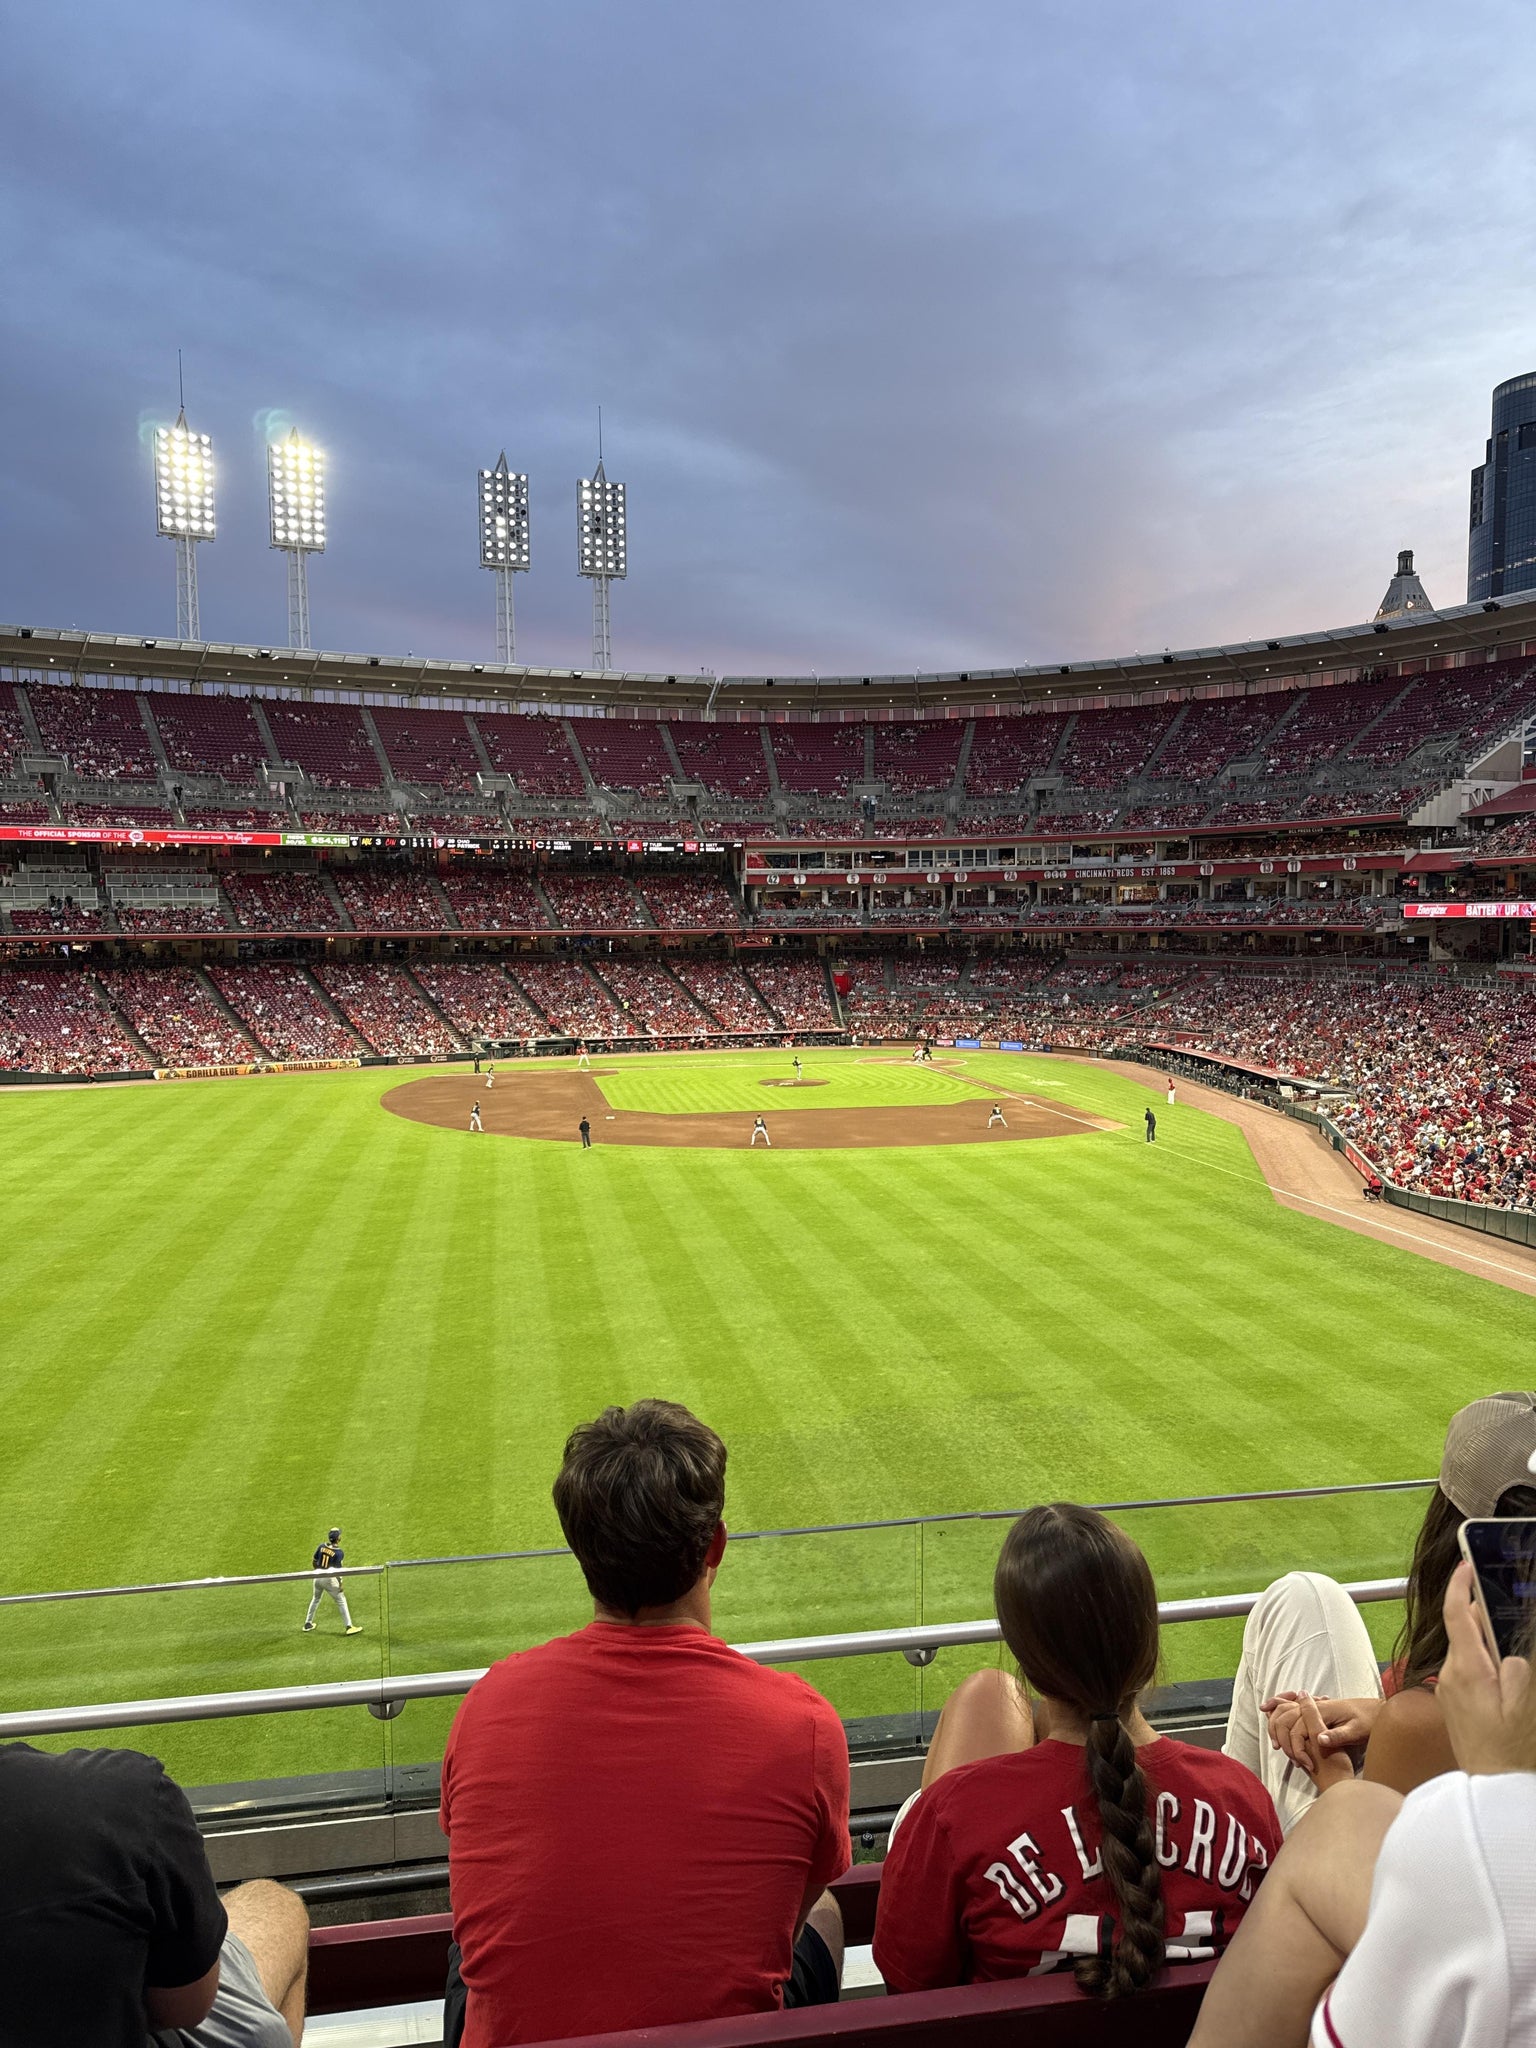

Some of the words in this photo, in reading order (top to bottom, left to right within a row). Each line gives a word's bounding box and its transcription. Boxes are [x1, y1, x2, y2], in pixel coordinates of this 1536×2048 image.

[33, 830, 66, 838] OFFICIAL
[375, 838, 382, 846] 3
[385, 838, 397, 846] CIN
[874, 873, 885, 883] 20
[1074, 869, 1114, 879] CINCINNATI
[1116, 868, 1135, 878] REDS
[1159, 866, 1176, 876] 1869
[1416, 904, 1449, 917] Energizer
[1465, 904, 1505, 916] BATTERY
[1505, 904, 1520, 916] UP!
[186, 1067, 219, 1078] GORILLA
[220, 1066, 238, 1077] GLUE
[282, 1062, 314, 1072] GORILLA
[315, 1061, 332, 1069] TAPE
[321, 1554, 330, 1569] 11
[984, 1832, 1065, 1921] DE
[1060, 1805, 1104, 1882] L
[1155, 1791, 1270, 1901] CRUZ
